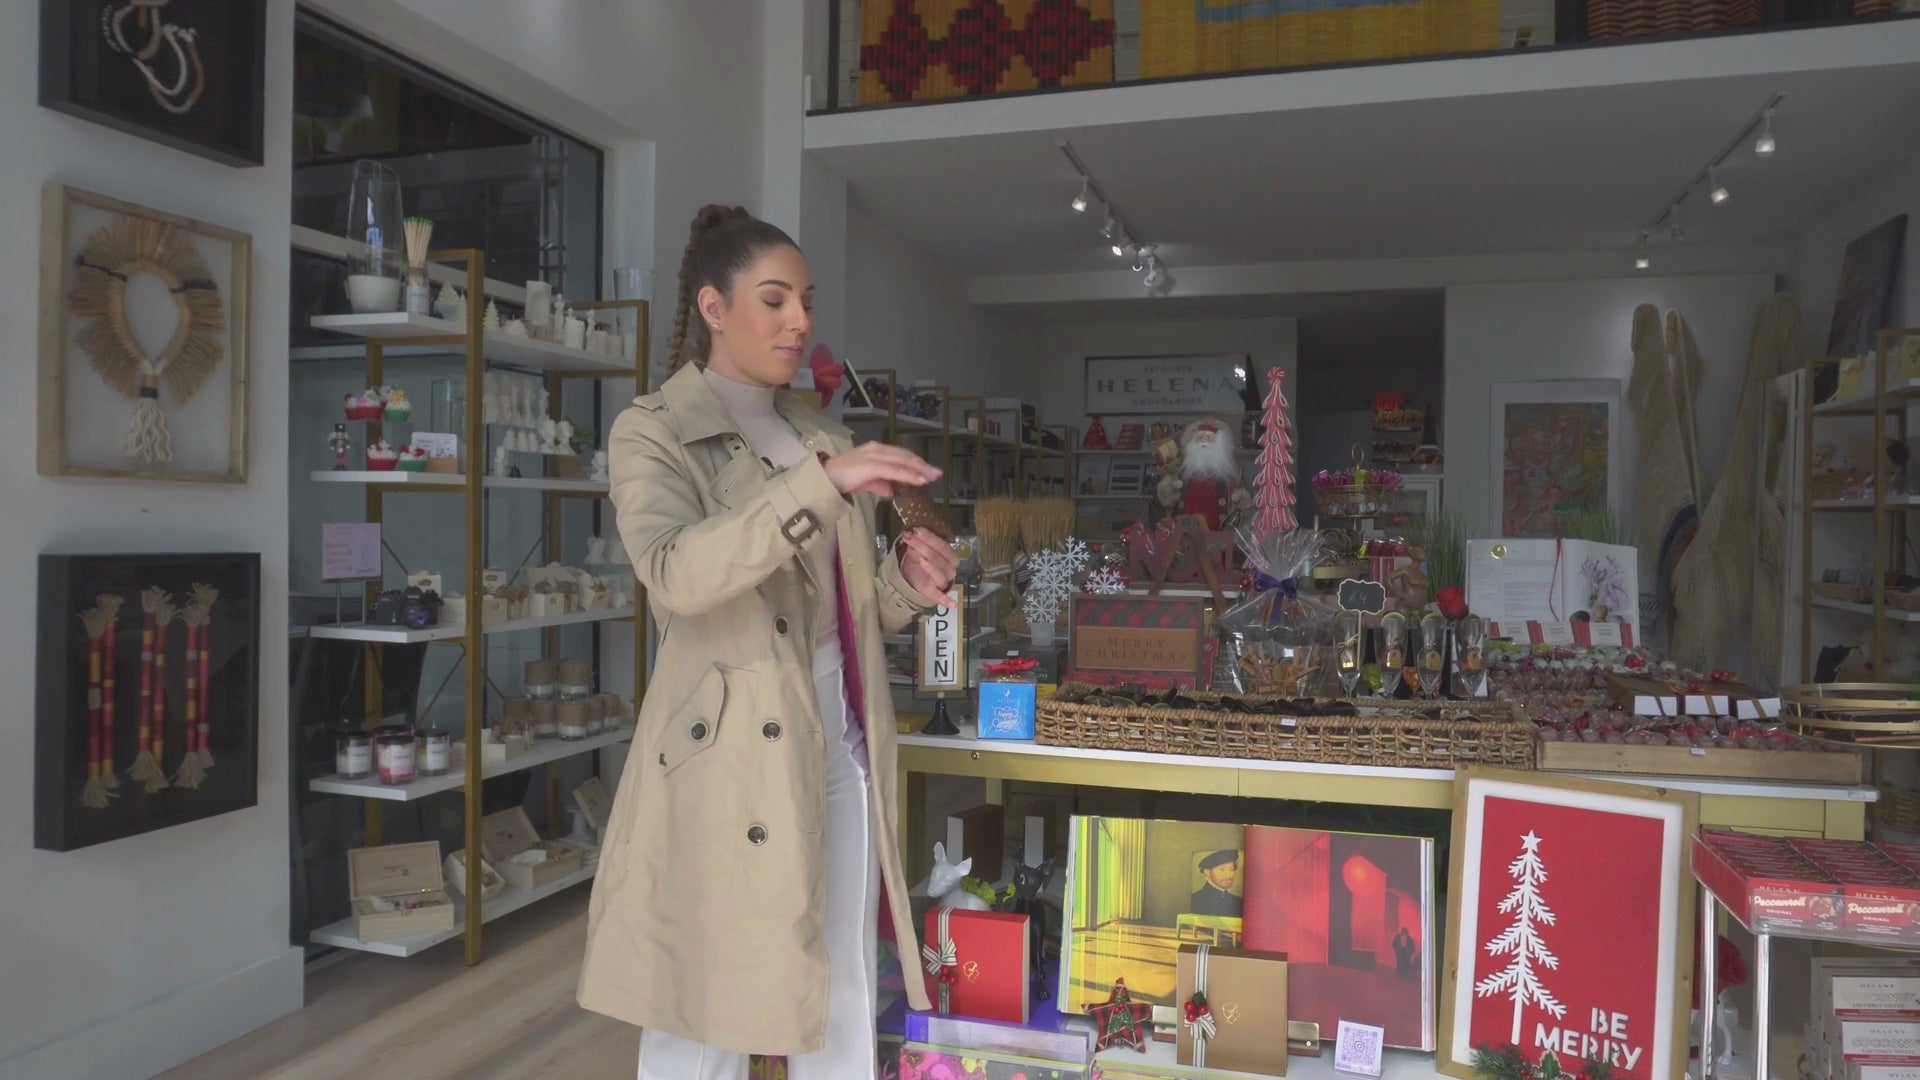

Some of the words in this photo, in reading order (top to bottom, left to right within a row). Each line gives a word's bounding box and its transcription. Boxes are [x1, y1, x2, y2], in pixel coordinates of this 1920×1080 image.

[1096, 377, 1238, 394] HELENA
[1107, 638, 1164, 648] MERRY
[1084, 649, 1187, 661] CHRISTMAS
[1590, 1007, 1629, 1040] BE
[1534, 1022, 1643, 1071] MERRY
